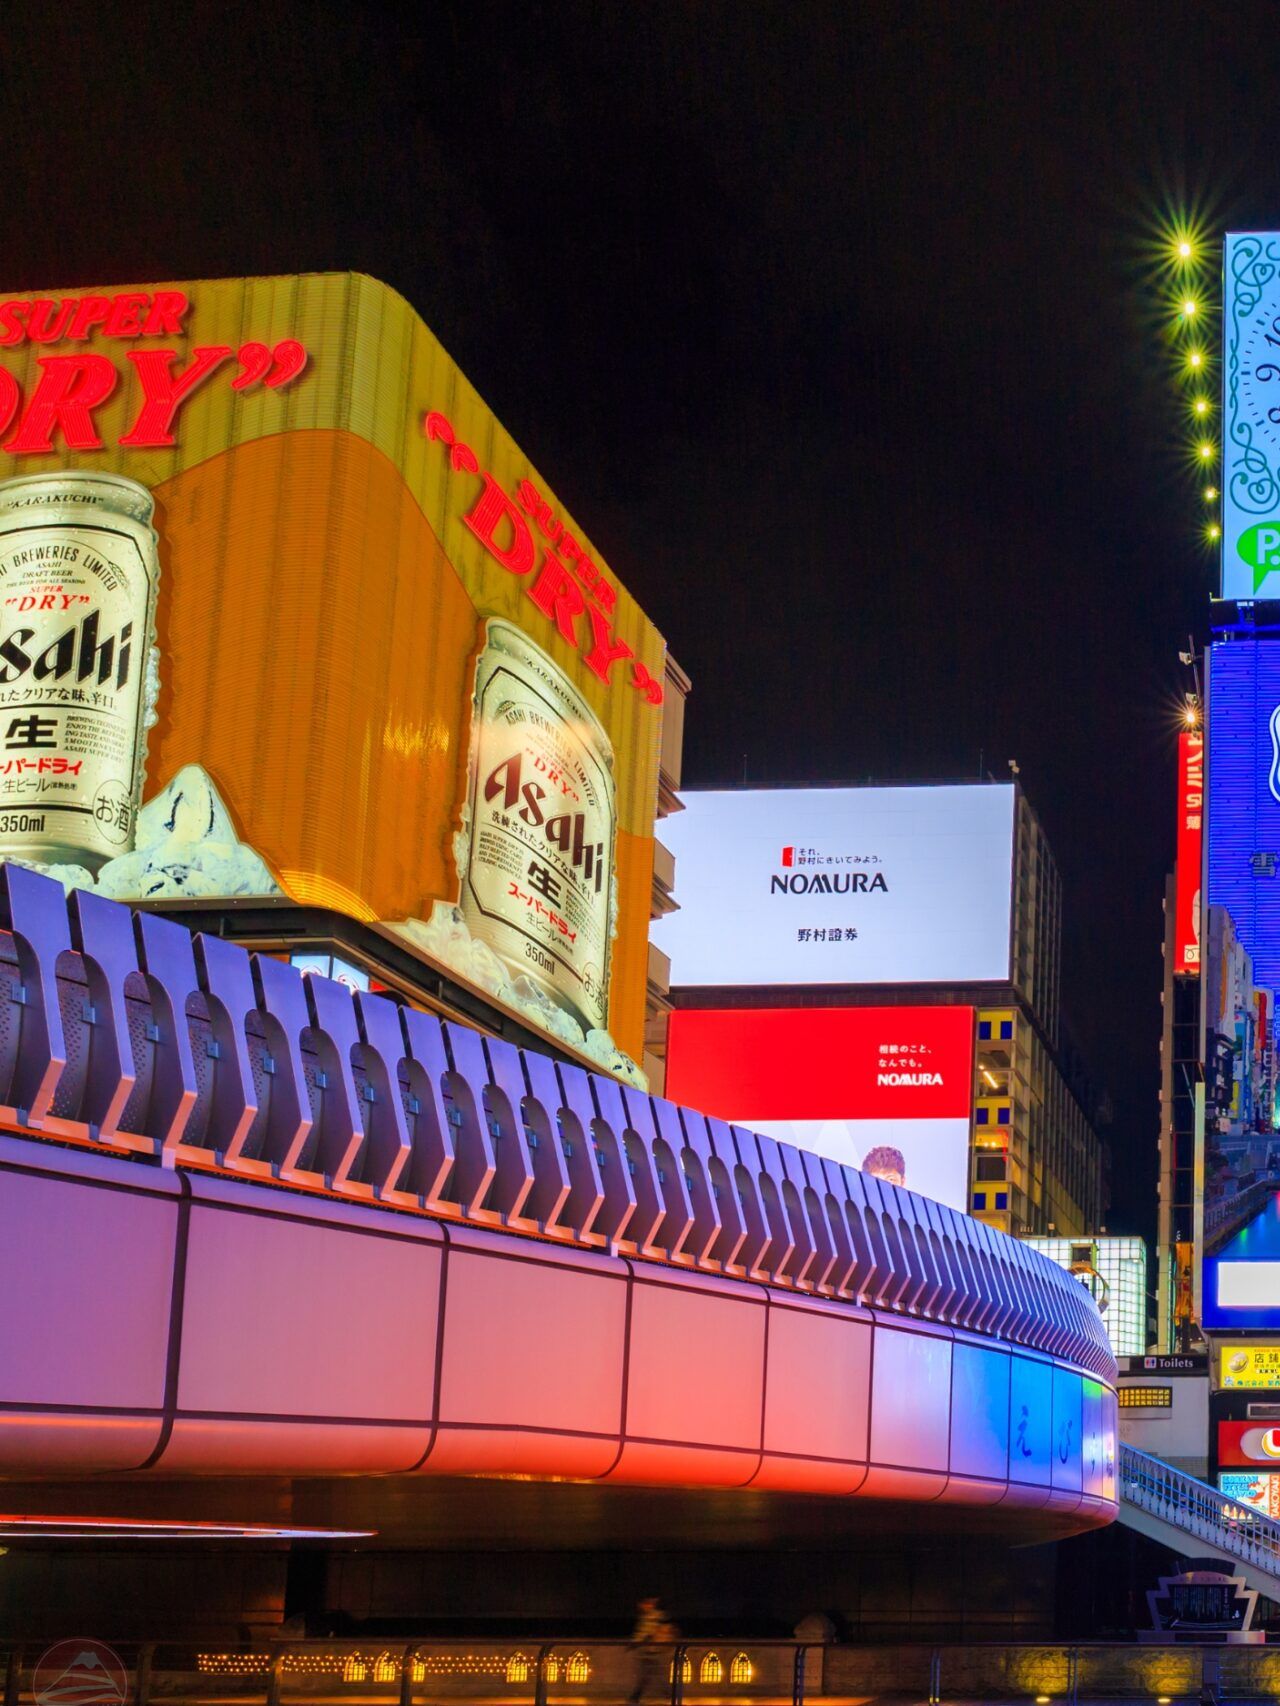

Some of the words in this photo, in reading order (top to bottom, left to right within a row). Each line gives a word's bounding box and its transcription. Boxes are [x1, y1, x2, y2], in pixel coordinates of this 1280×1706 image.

[0, 291, 189, 346] SUPER
[516, 479, 617, 614] SUPER
[13, 546, 79, 567] BREWERIES
[83, 554, 118, 591] LIMITED
[5, 714, 58, 750] 生
[0, 815, 45, 833] 350ml
[484, 752, 604, 893] Asahi
[528, 861, 562, 910] 生
[771, 872, 889, 895] NOMURA
[508, 882, 578, 944] スーパードライ
[797, 927, 859, 942] 野村證券
[525, 942, 555, 975] 350ml
[877, 1073, 944, 1087] NOMURA
[878, 1058, 923, 1068] なんでも。
[1159, 1357, 1194, 1369] Toilets
